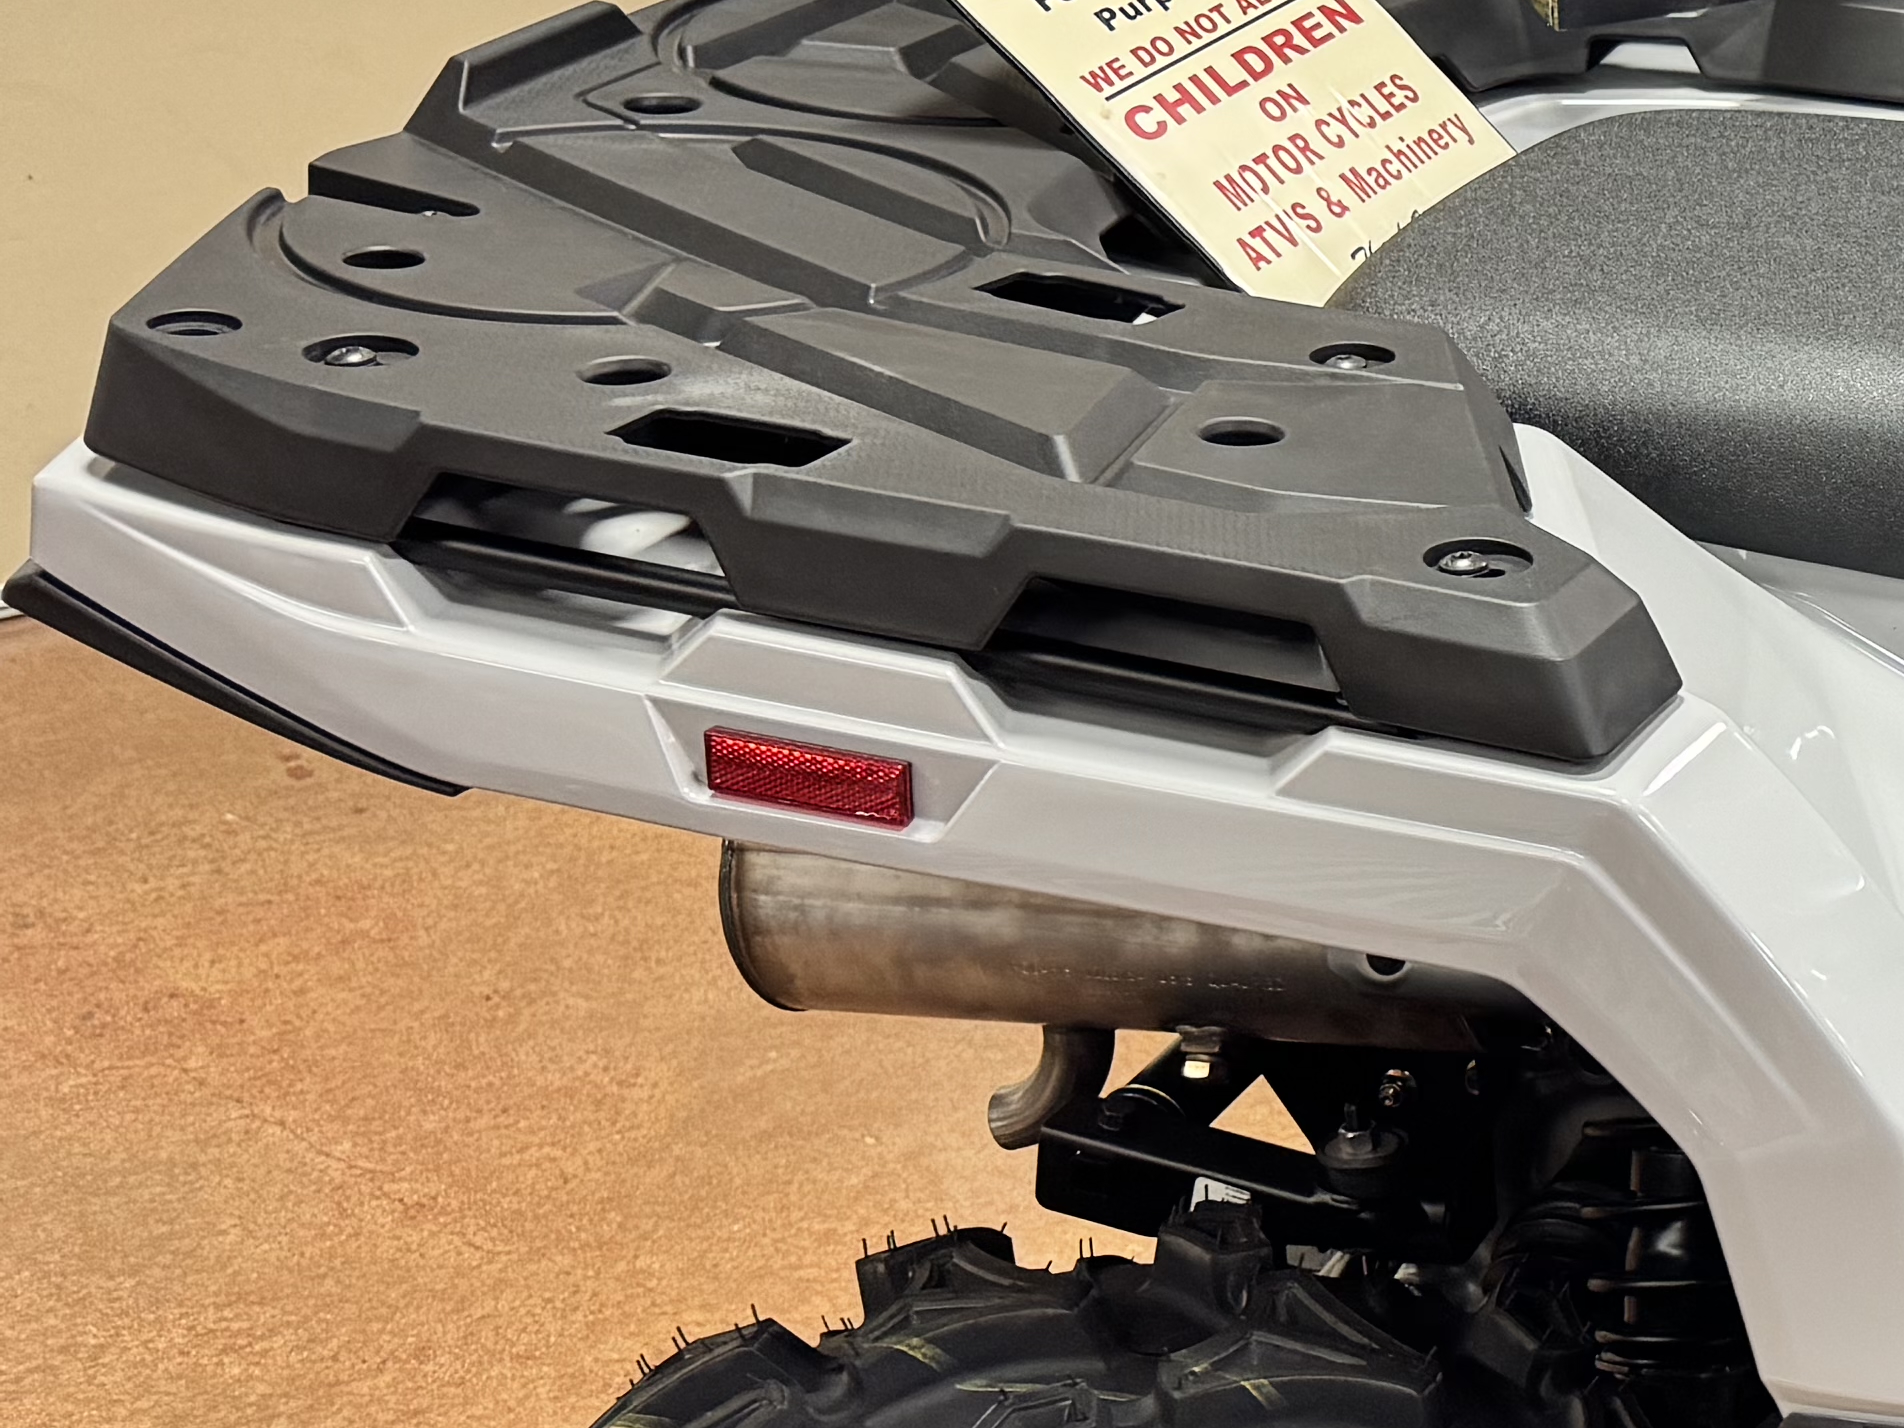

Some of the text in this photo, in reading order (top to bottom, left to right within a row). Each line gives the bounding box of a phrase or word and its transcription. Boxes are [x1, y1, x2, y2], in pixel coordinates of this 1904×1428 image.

[1080, 57, 1128, 93] WE
[1131, 35, 1175, 67] DO
[1180, 6, 1233, 51] NOT
[1213, 73, 1421, 212] MOTOR CYCLES
[1259, 83, 1311, 123] ON
[1318, 187, 1347, 219] &
[1340, 113, 1477, 206] Machinery
